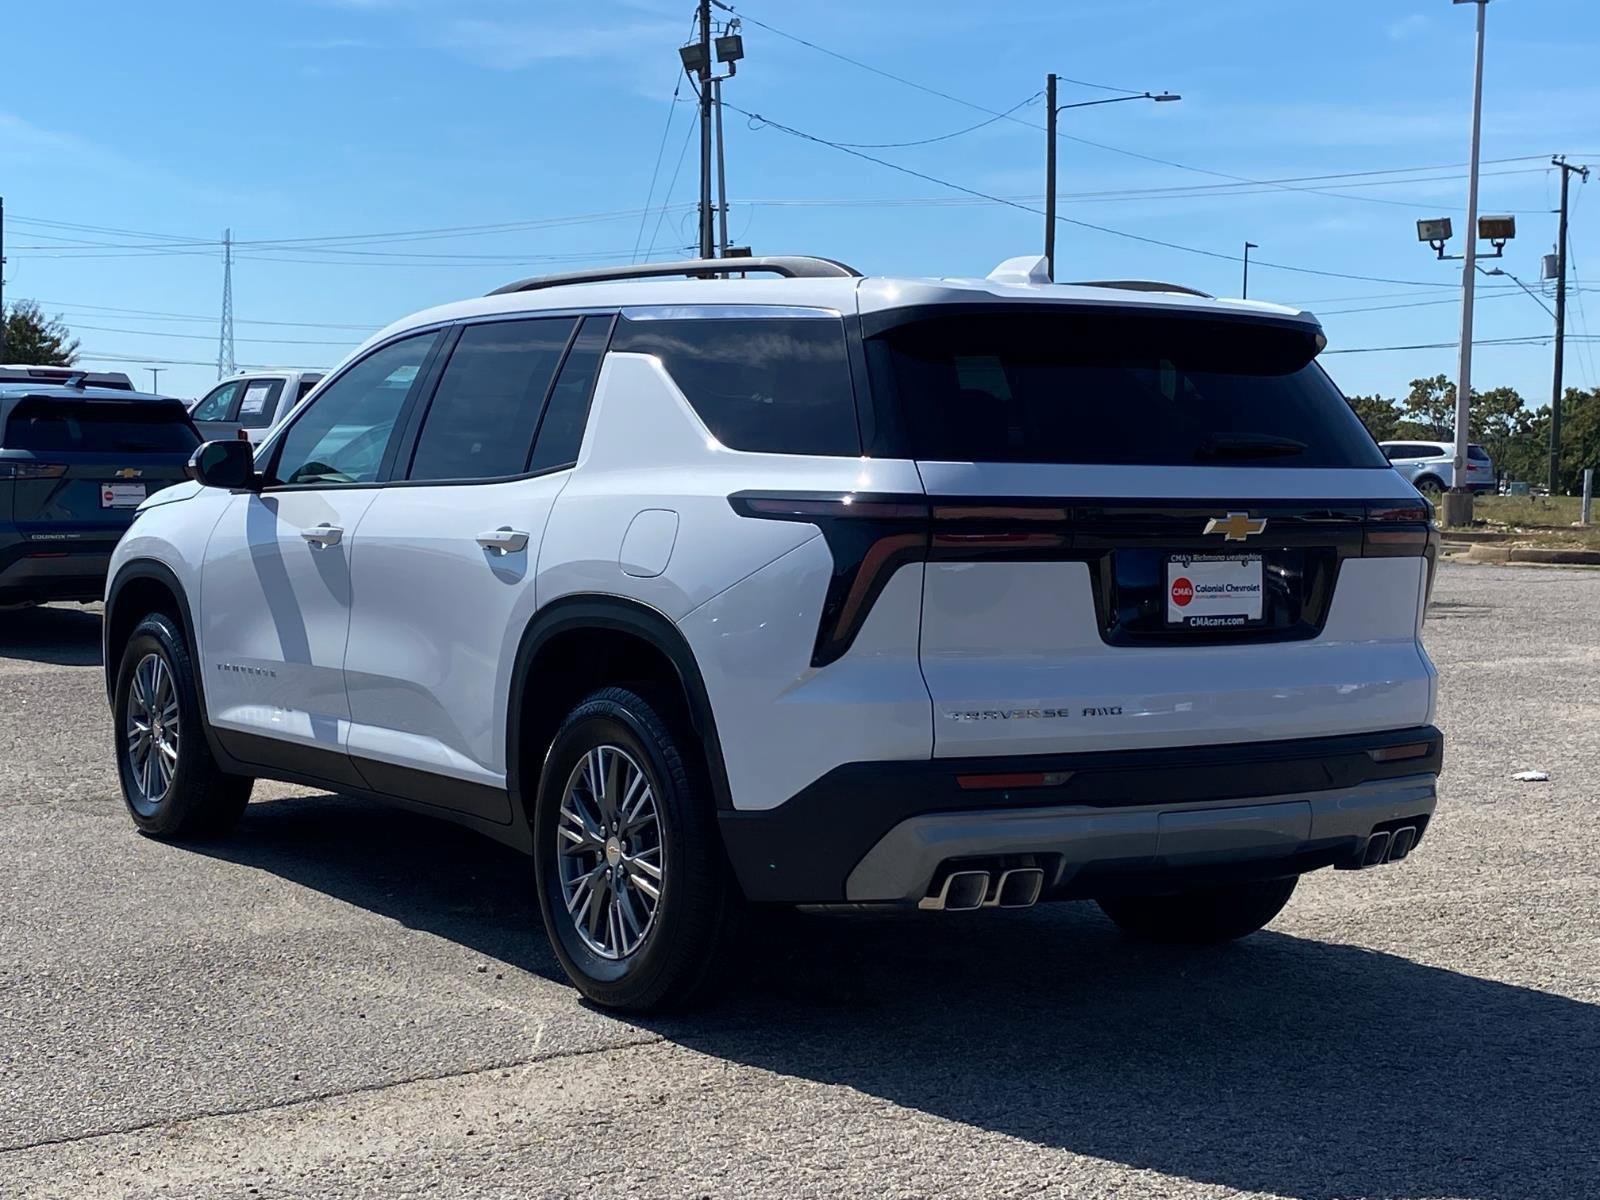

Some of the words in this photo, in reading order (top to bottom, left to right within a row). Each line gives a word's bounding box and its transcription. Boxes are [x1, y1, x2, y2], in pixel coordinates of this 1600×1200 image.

[1172, 588, 1193, 596] CMA's
[1195, 584, 1225, 593] Colonial
[1225, 584, 1261, 593] Chevrolet
[1190, 617, 1245, 627] CMAcars.com
[950, 708, 1069, 721] TRAVERSE
[1082, 706, 1123, 717] AWD
